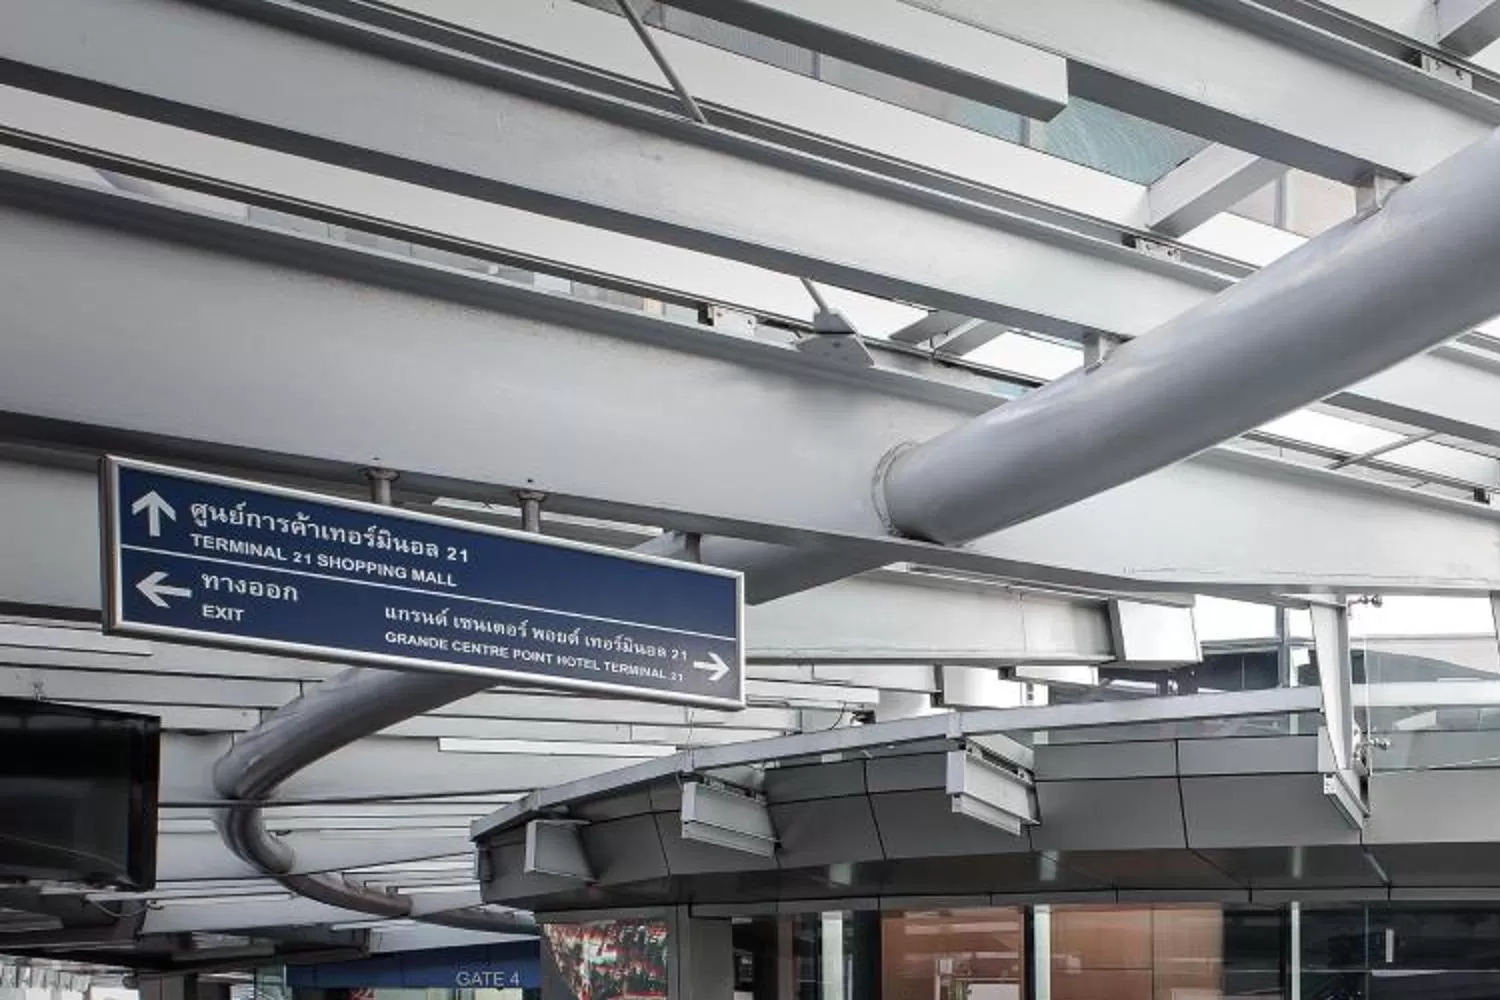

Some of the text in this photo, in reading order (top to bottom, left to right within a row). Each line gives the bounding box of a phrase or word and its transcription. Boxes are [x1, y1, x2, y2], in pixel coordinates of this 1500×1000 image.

[190, 501, 469, 563] ศูนย์การค้าเทอร์มินอล 21
[189, 533, 457, 587] TERMINAL 21 SHOPPING MALL
[201, 573, 298, 602] ทางออก
[202, 604, 245, 621] EXIT
[385, 631, 684, 682] GRANDE CENTRE POINT HOTEL TERMINAL 21
[671, 649, 688, 661] 21
[456, 971, 519, 987] GATE 4
